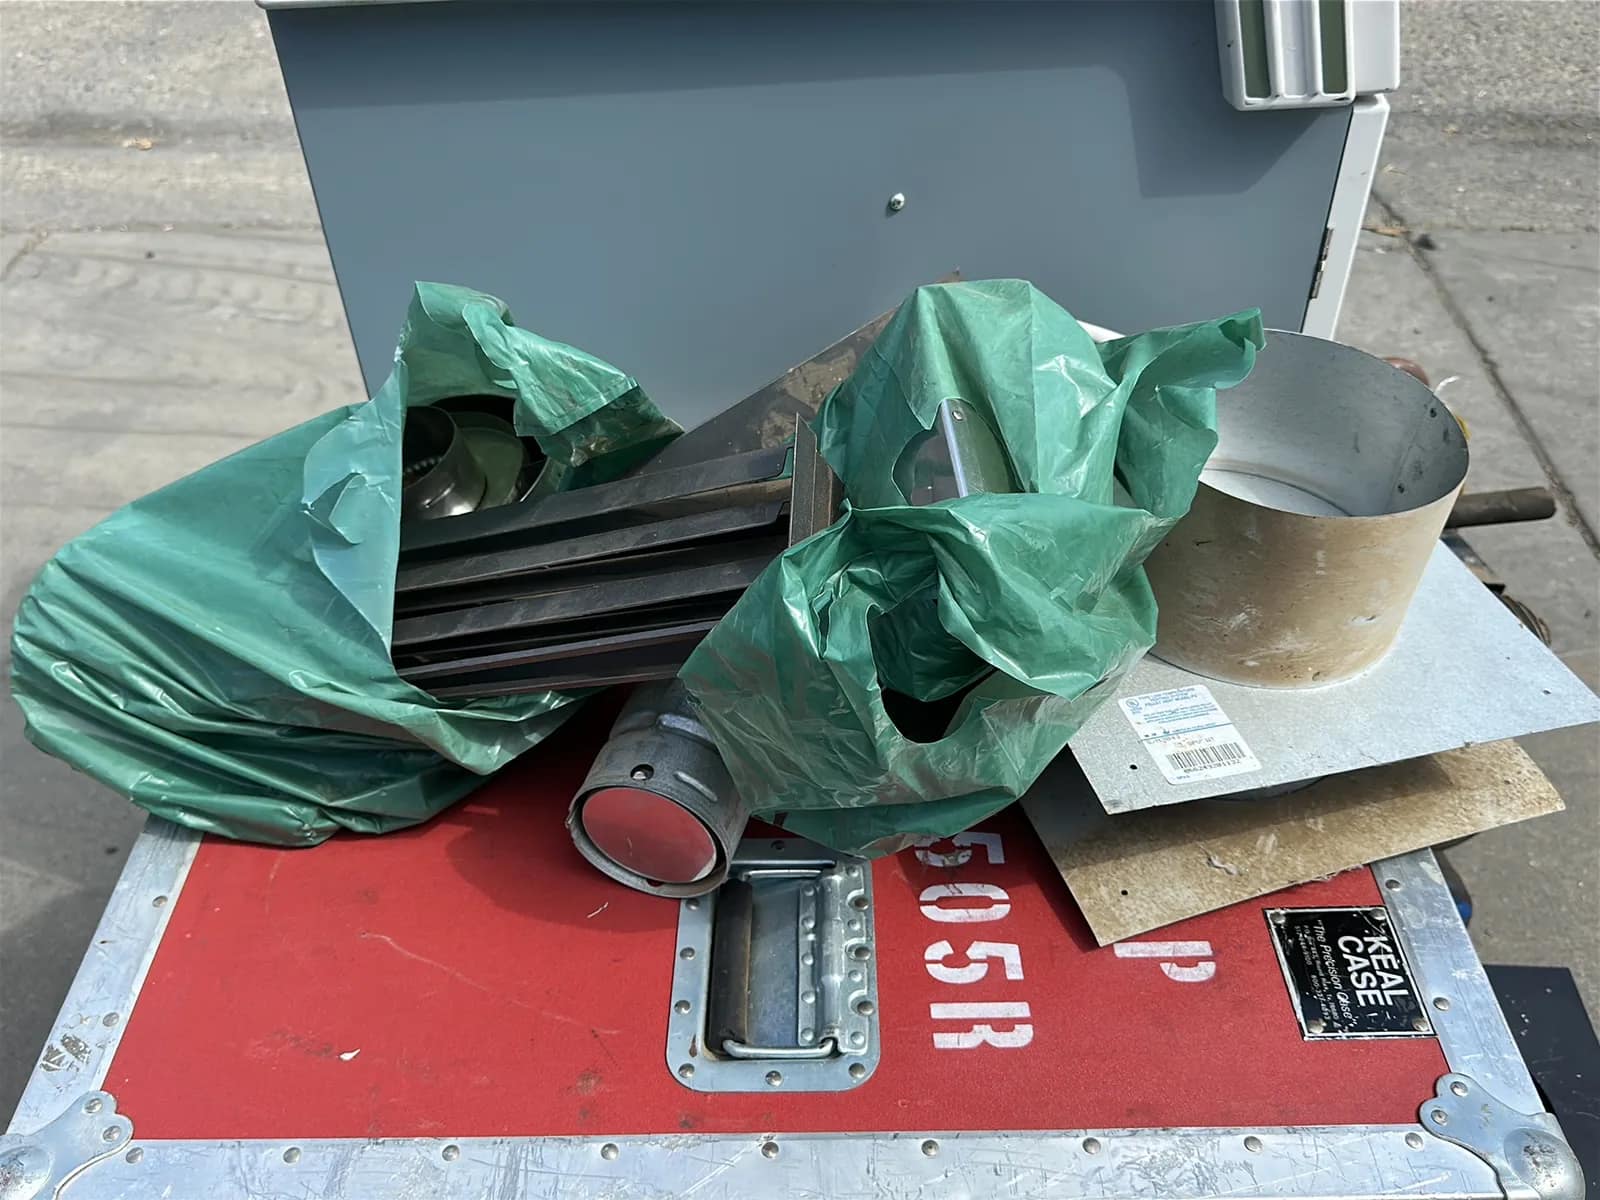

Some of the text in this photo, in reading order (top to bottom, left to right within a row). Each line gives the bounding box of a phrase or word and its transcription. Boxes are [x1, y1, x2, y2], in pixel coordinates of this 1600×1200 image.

[1320, 944, 1343, 990] Precision
[1337, 935, 1385, 1006] CASE
[1363, 936, 1409, 1006] KEAL
